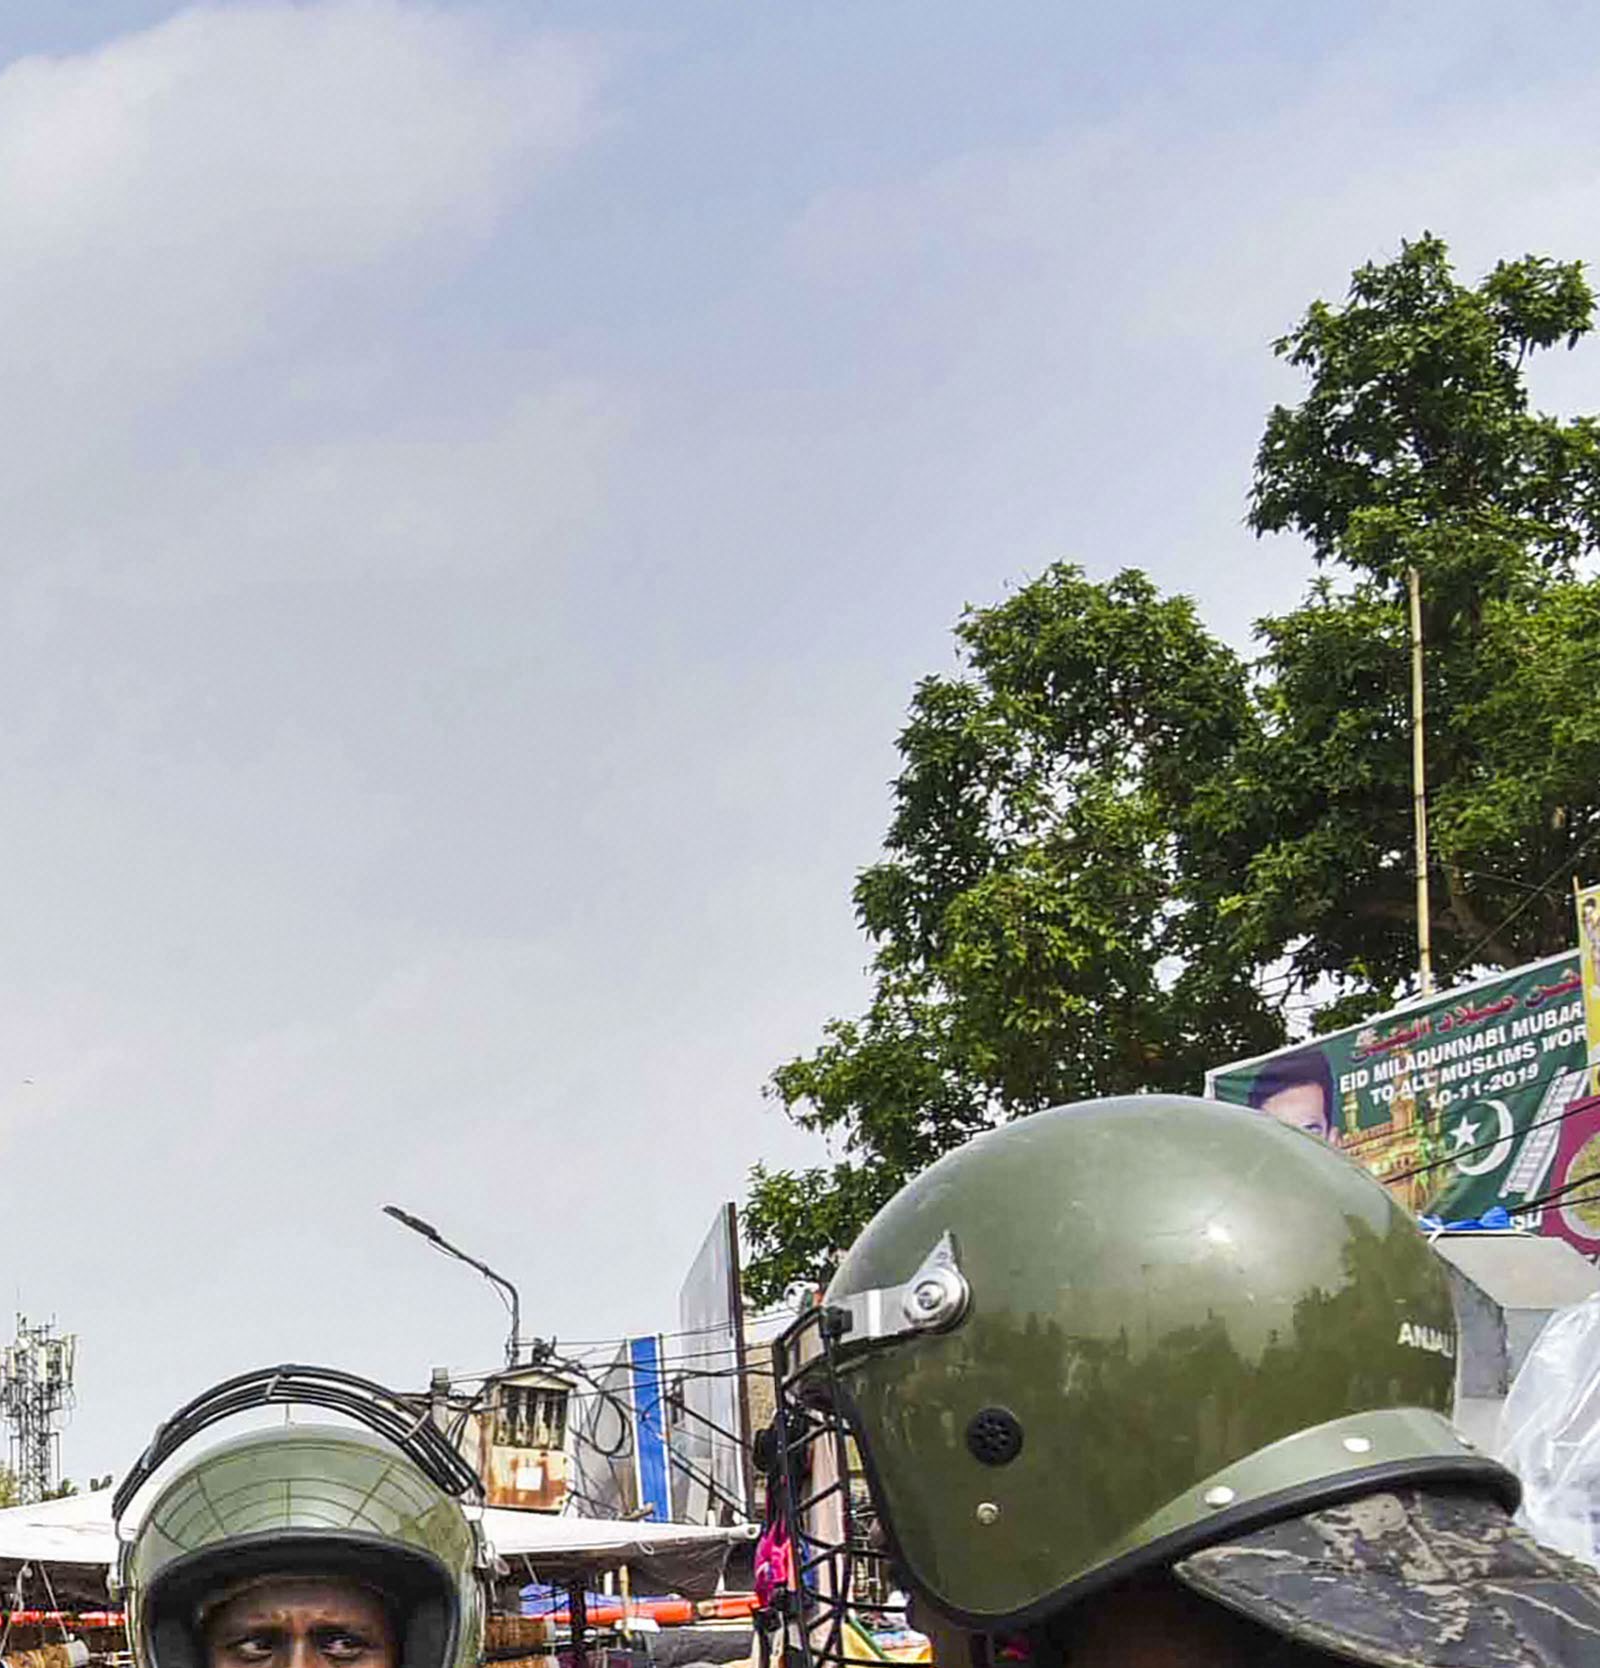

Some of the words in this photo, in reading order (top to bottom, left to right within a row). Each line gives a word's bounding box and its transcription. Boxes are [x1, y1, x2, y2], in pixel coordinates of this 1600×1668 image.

[1340, 1069, 1369, 1093] EID
[1373, 1027, 1507, 1084] MILADUNNABI
[1512, 1000, 1584, 1040] MUBAR
[1370, 1085, 1396, 1105] TO
[1400, 1070, 1439, 1100] ALL
[1441, 1042, 1538, 1084] MUSLIMS
[1542, 1024, 1587, 1053] WOR
[1427, 1063, 1540, 1109] 10-11-2019
